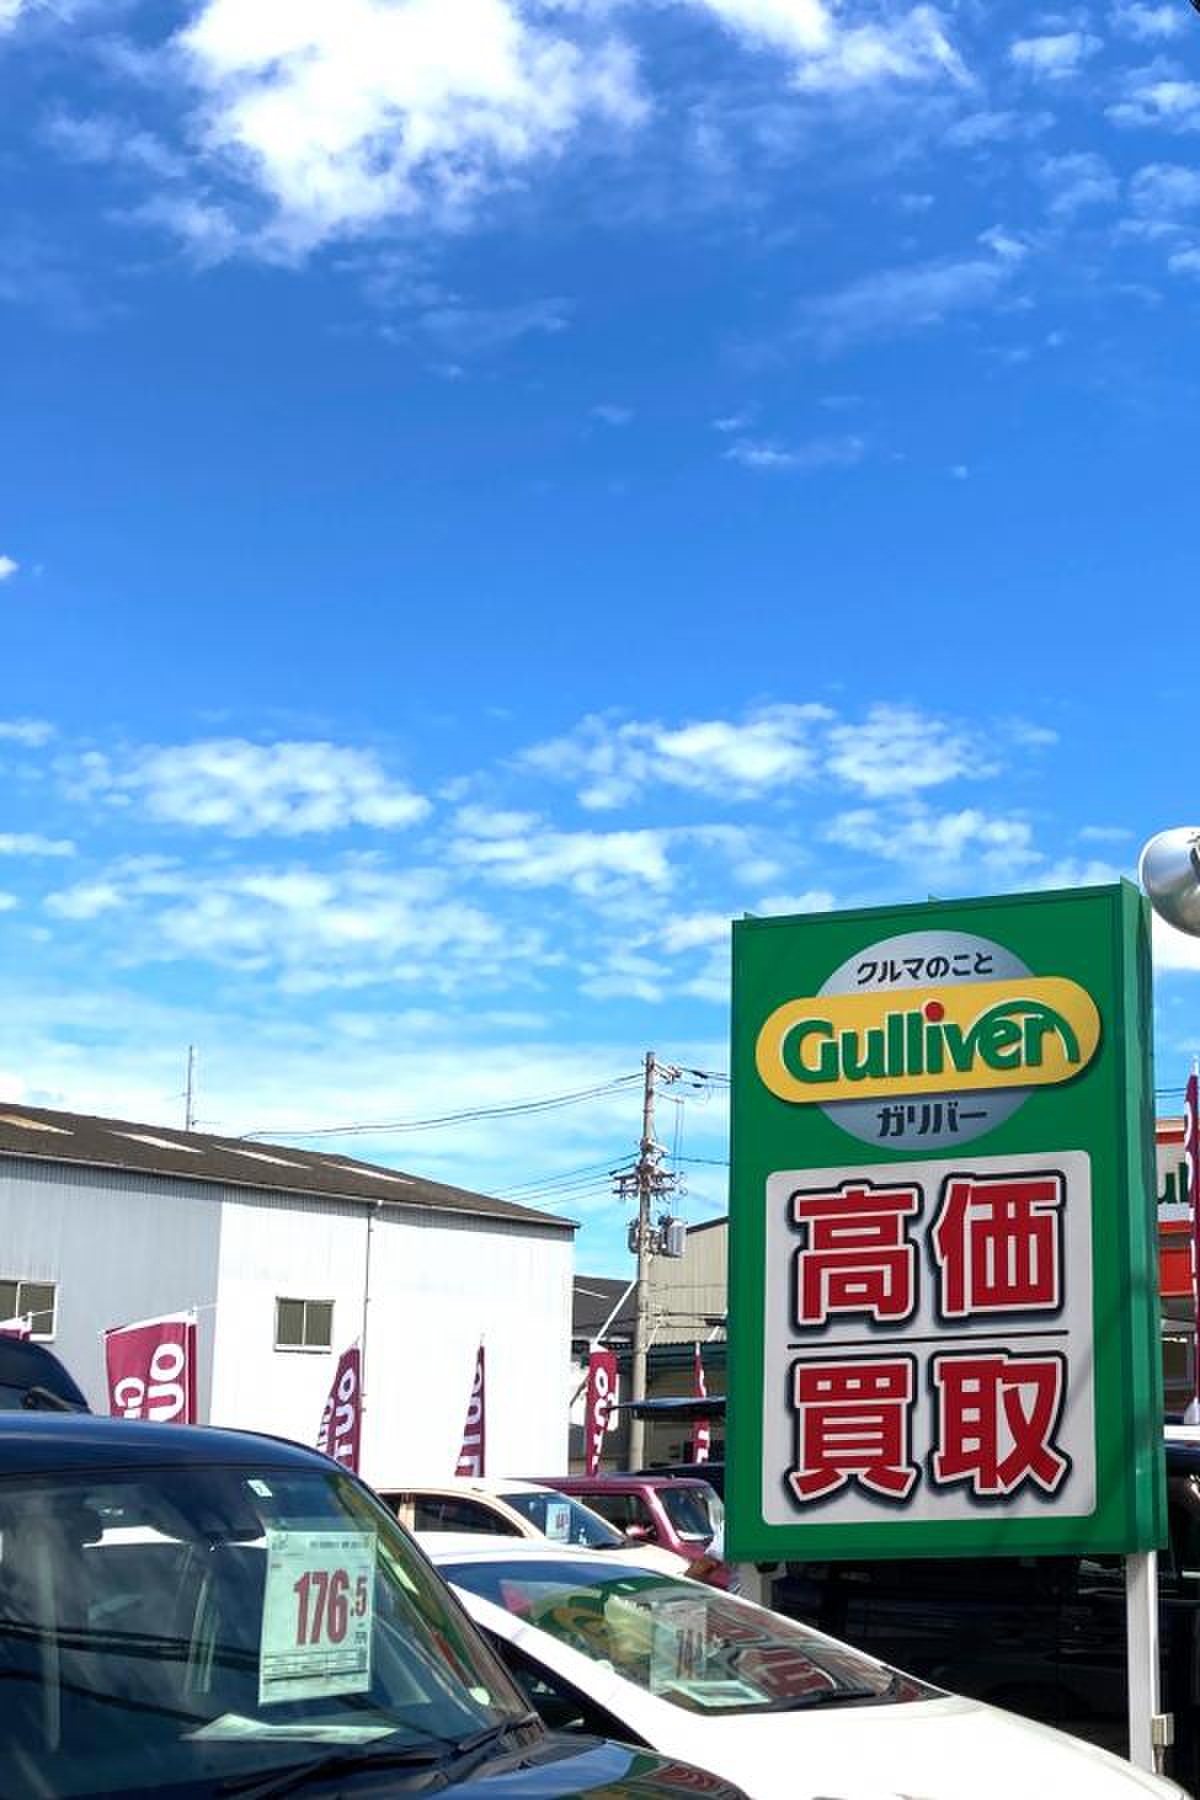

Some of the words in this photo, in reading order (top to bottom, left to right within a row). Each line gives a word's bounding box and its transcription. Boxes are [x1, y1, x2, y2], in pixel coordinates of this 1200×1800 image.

[856, 951, 994, 986] クルマのこと
[780, 998, 1081, 1085] Gulliver
[876, 1104, 988, 1139] ガリバー
[788, 1171, 1067, 1330] 高価
[788, 1350, 1071, 1503] 買取
